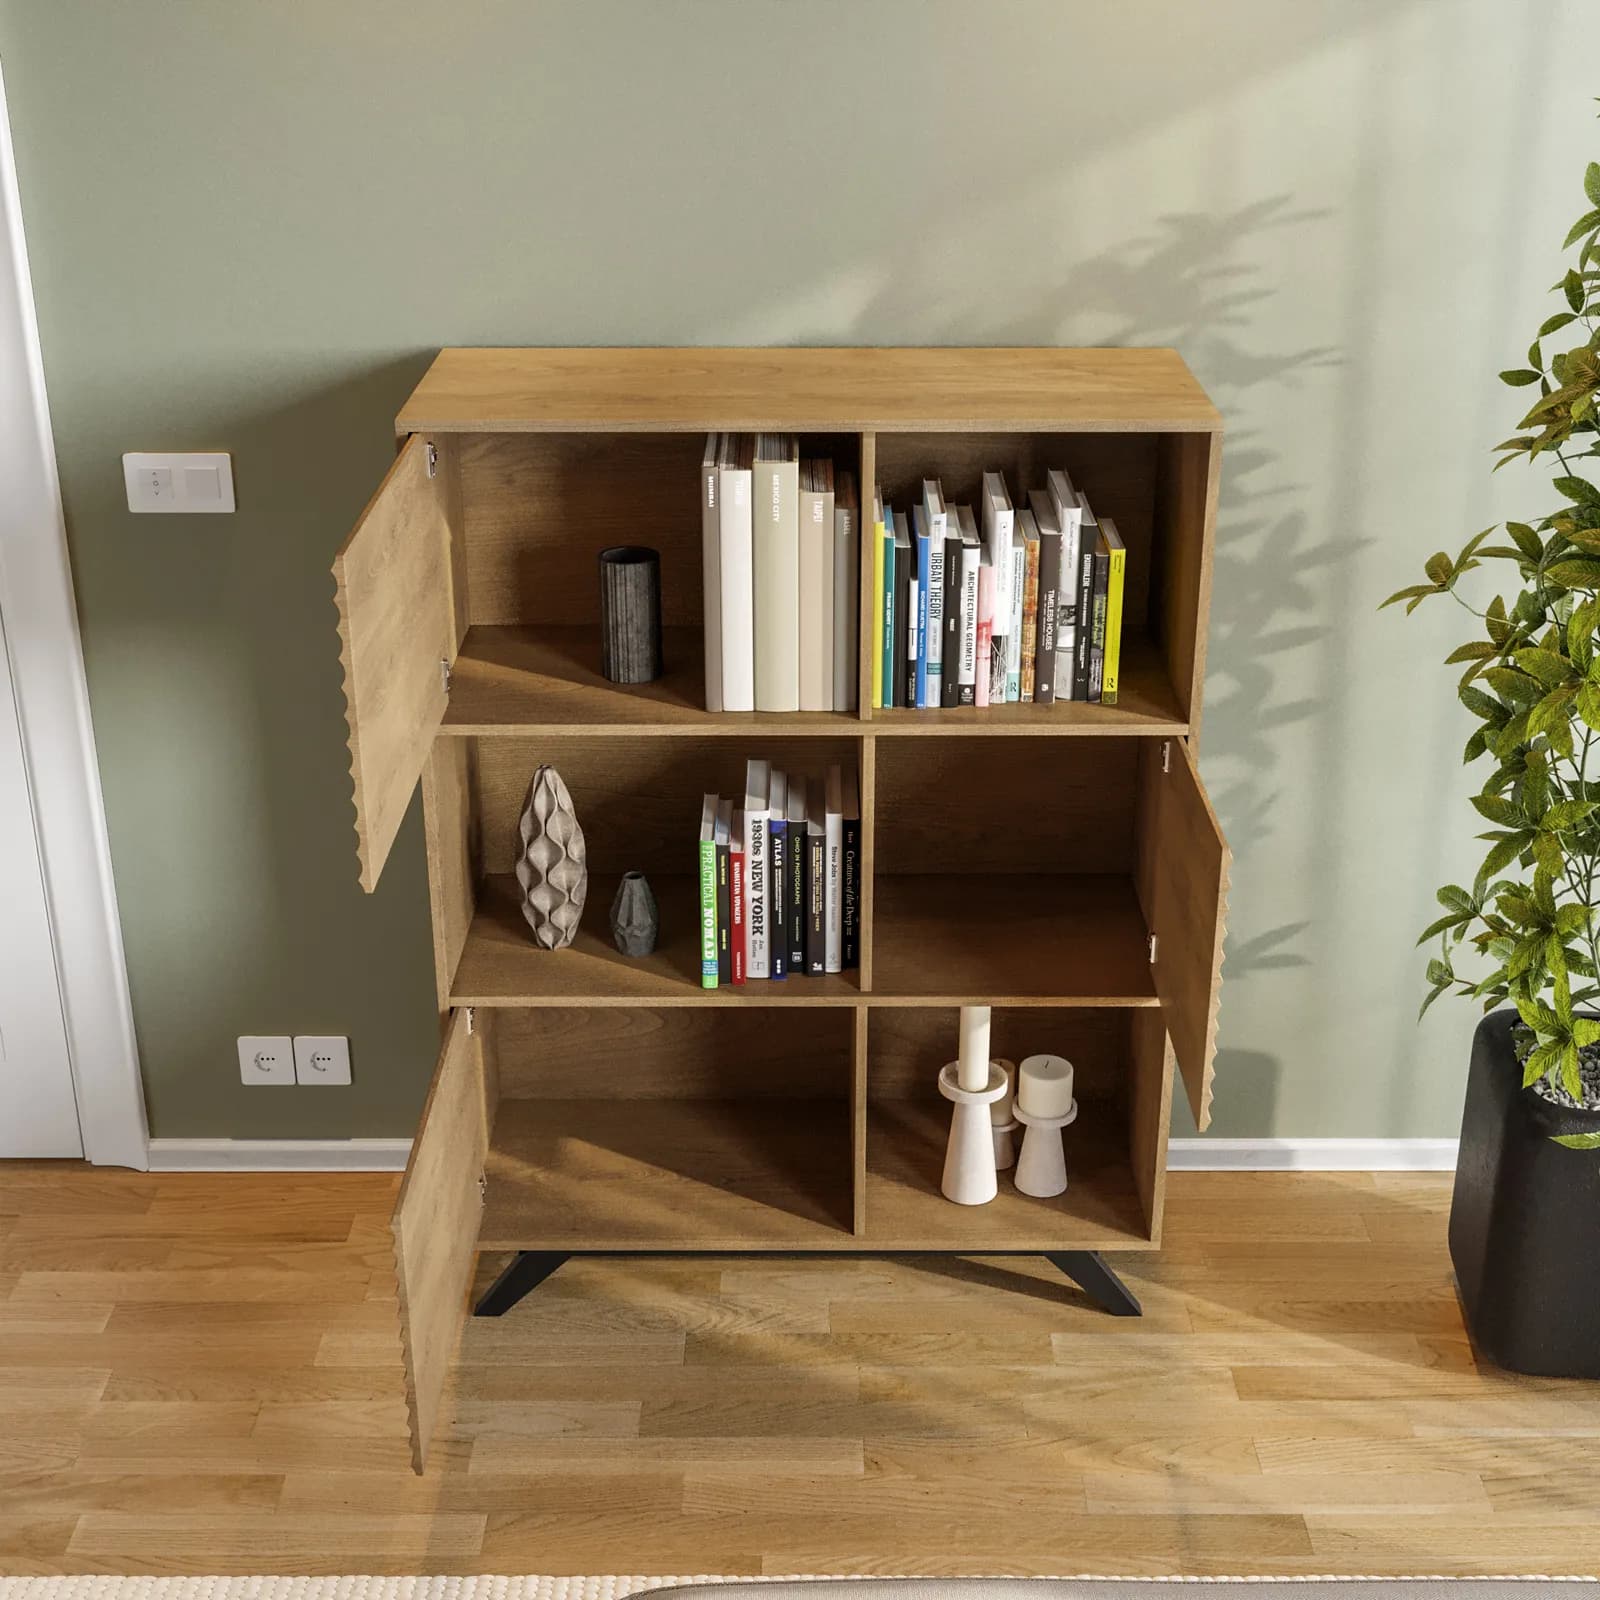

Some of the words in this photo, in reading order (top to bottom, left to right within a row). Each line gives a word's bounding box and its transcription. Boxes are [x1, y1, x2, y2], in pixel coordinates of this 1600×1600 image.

[813, 500, 824, 523] TAIPEI
[931, 552, 943, 583] URBAN
[930, 586, 943, 621] THEORY
[966, 571, 976, 630] ARCHITECTURAL
[1046, 590, 1055, 622] TIMELESS
[965, 633, 974, 673] GEOMETRY
[1045, 623, 1053, 651] HOUSES
[752, 819, 763, 857] 1930s
[774, 838, 782, 866] ATLAS
[831, 846, 839, 863] Steve
[846, 850, 855, 884] Creatures
[703, 851, 713, 906] PRACTICAL
[752, 859, 764, 893] NEW
[831, 864, 839, 878] Jobs
[844, 886, 855, 894] of
[846, 894, 855, 905] the
[752, 895, 764, 936] YORK
[843, 906, 855, 926] Deep
[703, 907, 714, 959] NOMAD
